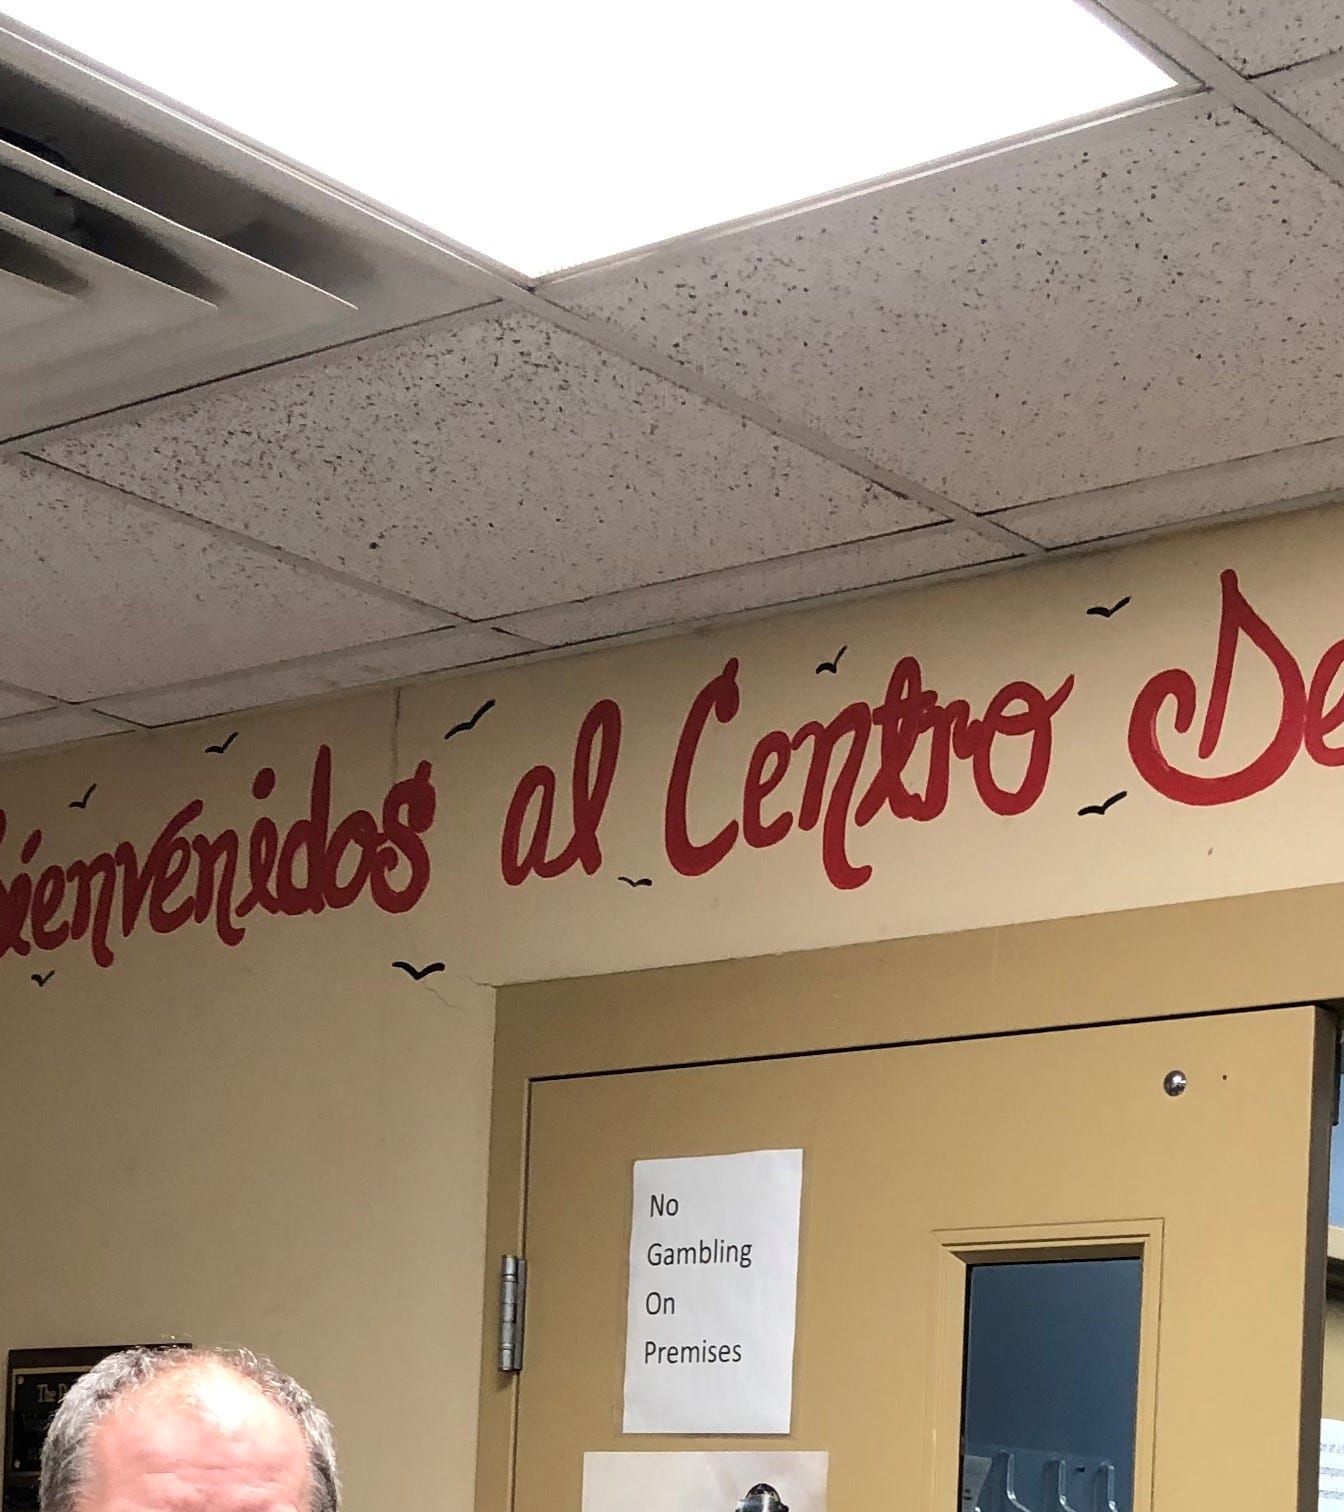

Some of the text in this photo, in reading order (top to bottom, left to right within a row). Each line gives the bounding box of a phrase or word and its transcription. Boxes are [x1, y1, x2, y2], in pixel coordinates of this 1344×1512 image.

[500, 700, 621, 886] al
[665, 657, 1075, 890] Centro
[650, 1194, 679, 1218] No
[647, 1239, 753, 1268] Gambling
[645, 1292, 675, 1316] On
[645, 1340, 742, 1364] Premises
